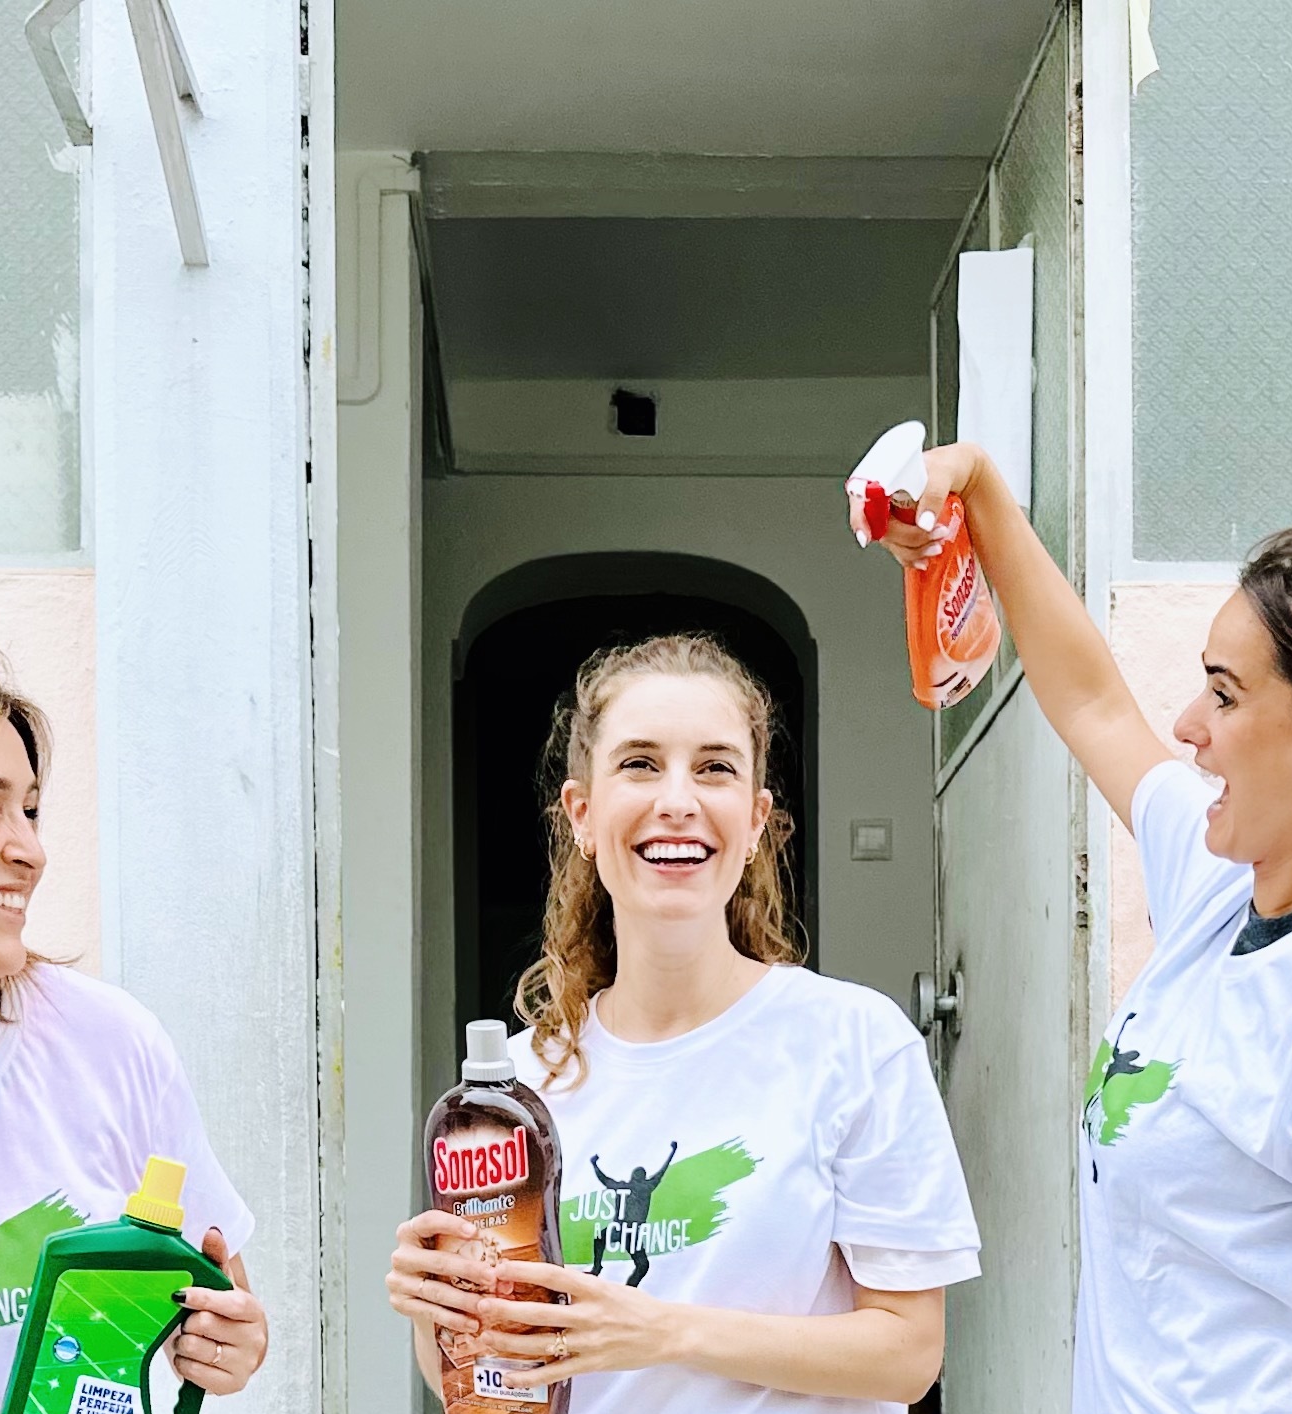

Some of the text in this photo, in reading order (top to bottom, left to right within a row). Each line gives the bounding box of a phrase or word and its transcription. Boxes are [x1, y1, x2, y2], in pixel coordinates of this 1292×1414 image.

[435, 1127, 527, 1191] Sonasol
[454, 1195, 515, 1217] Brilhante
[569, 1188, 631, 1222] JUST
[473, 1213, 508, 1230] DEIRAS
[593, 1218, 692, 1255] A CHANGE
[81, 1383, 133, 1405] LIMPEZA
